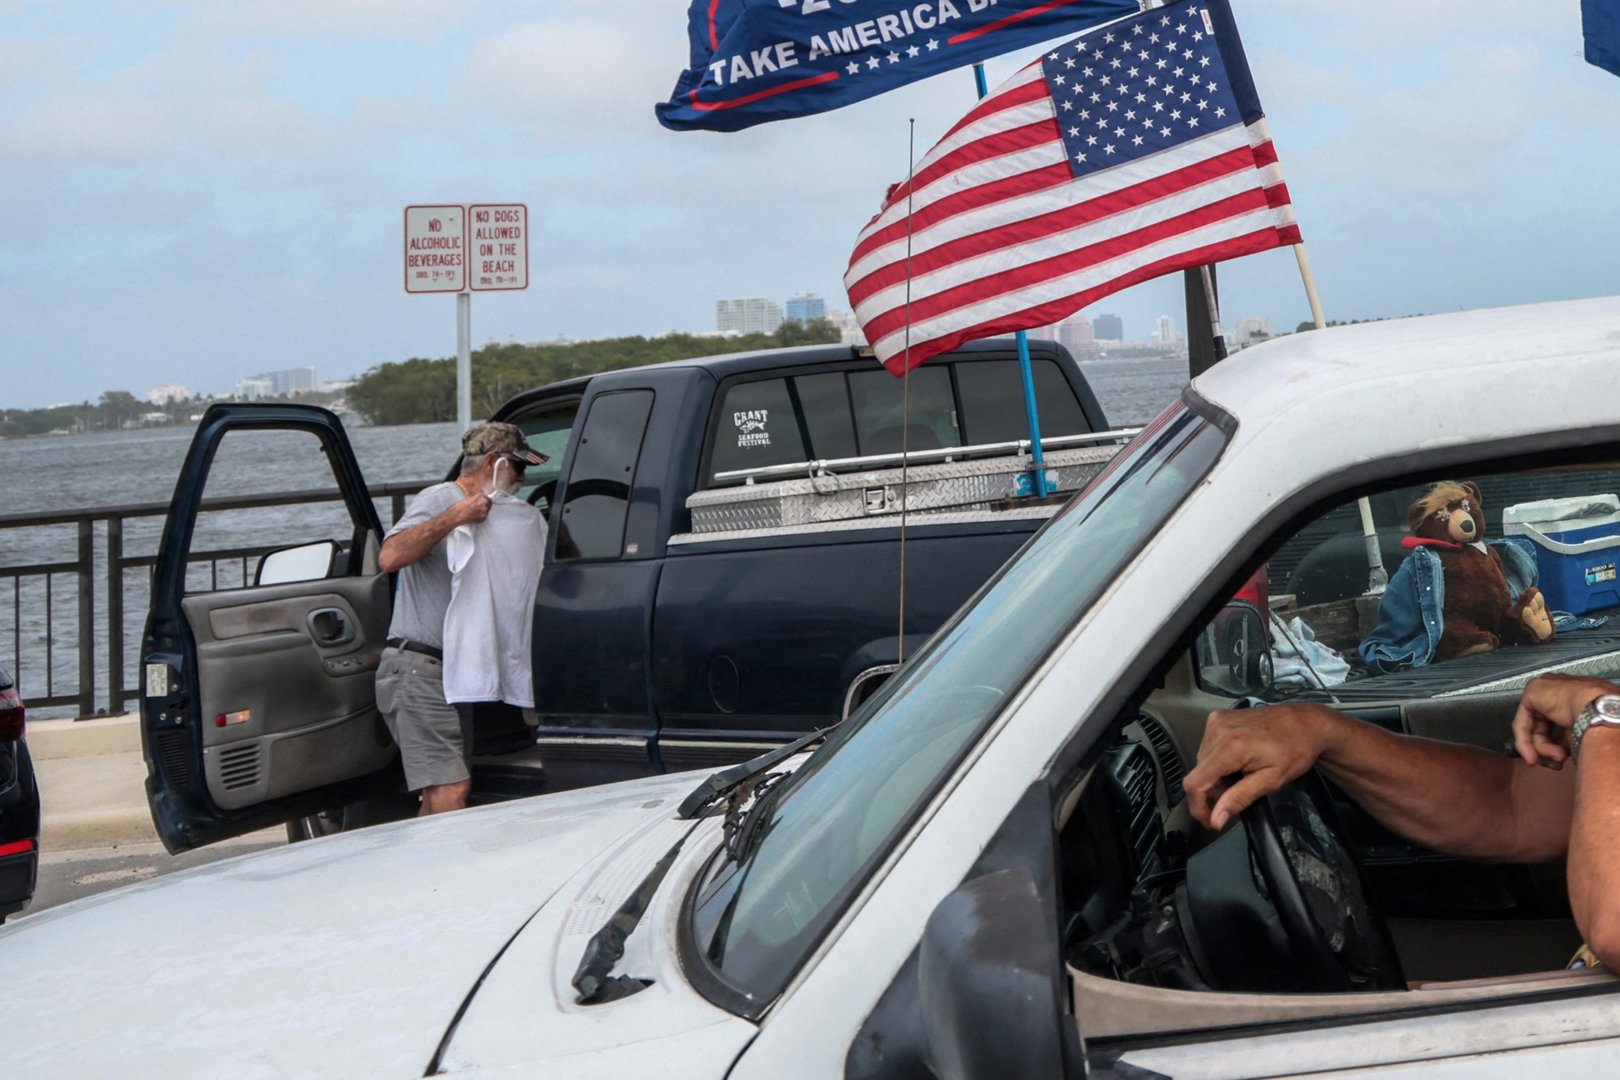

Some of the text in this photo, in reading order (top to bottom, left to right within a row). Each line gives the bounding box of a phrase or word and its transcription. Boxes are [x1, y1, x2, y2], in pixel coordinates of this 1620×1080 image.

[709, 42, 799, 86] TAKE
[476, 210, 520, 223] NO DOGS
[428, 219, 442, 233] NO
[476, 227, 521, 239] ALLOWED
[409, 237, 460, 250] ALCOHOLIC
[479, 243, 517, 257] ON THE
[408, 254, 462, 267] BEVERAGES
[482, 260, 515, 273] BEACH
[733, 410, 768, 426] GRANT
[737, 438, 771, 447] FESTIVAL
[738, 432, 769, 441] SEAFOOD
